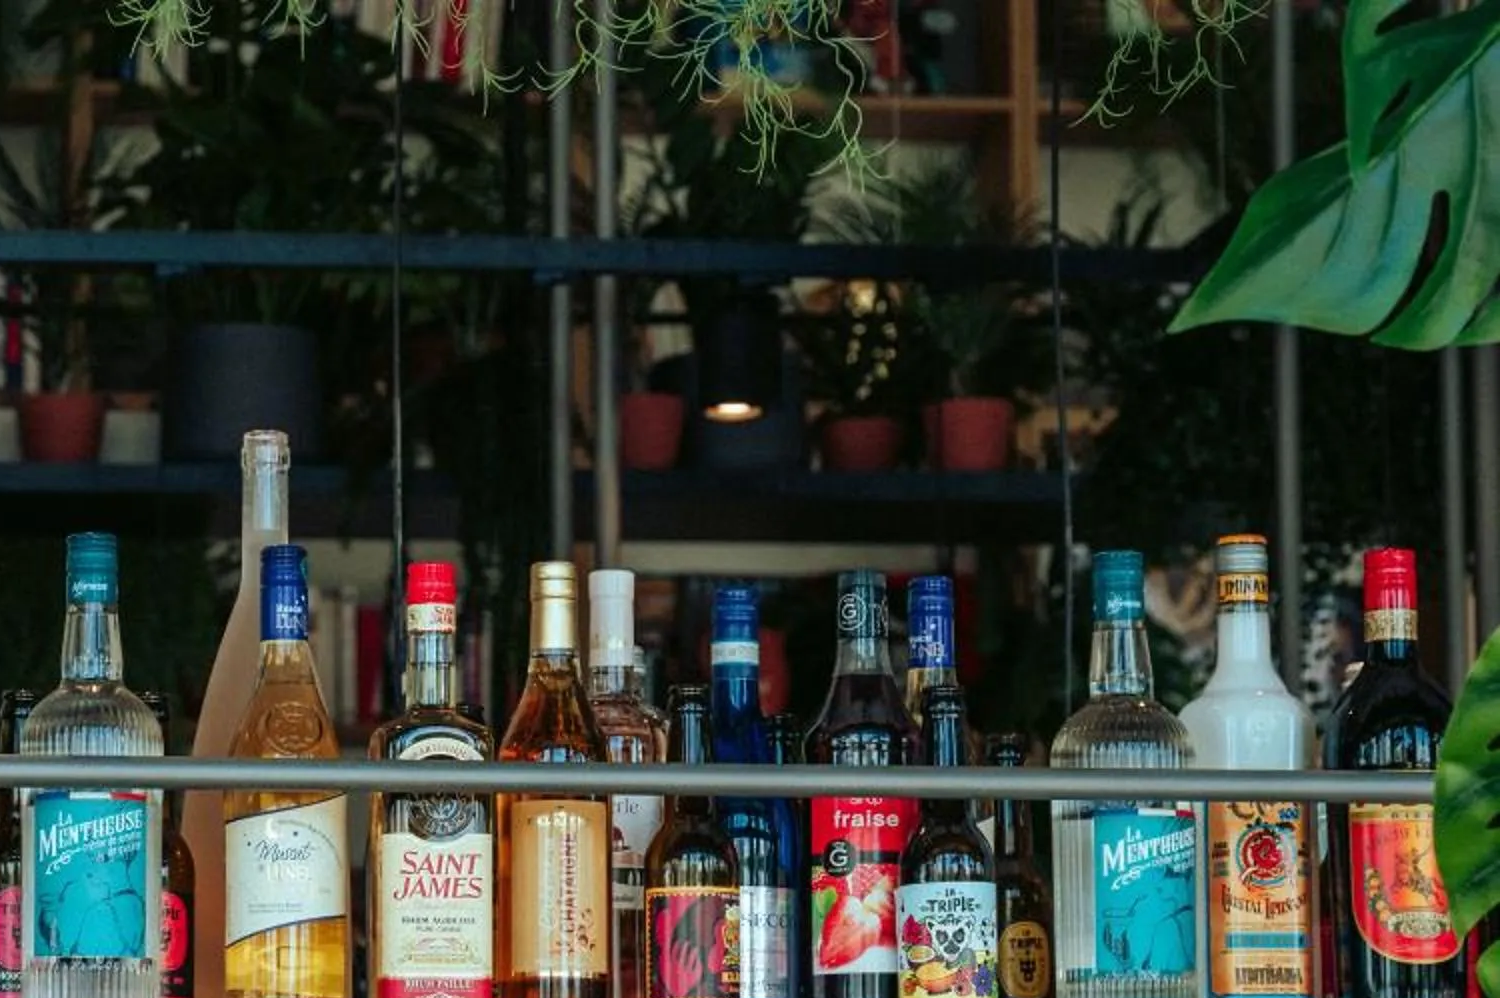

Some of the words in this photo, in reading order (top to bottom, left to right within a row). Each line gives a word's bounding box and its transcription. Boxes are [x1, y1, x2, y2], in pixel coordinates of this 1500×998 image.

[834, 810, 899, 828] fraise
[40, 811, 145, 862] MENTHEUSE
[401, 851, 482, 875] SAINT
[830, 850, 849, 867] G
[393, 877, 483, 900] JAMES
[925, 897, 975, 913] TRIPLE
